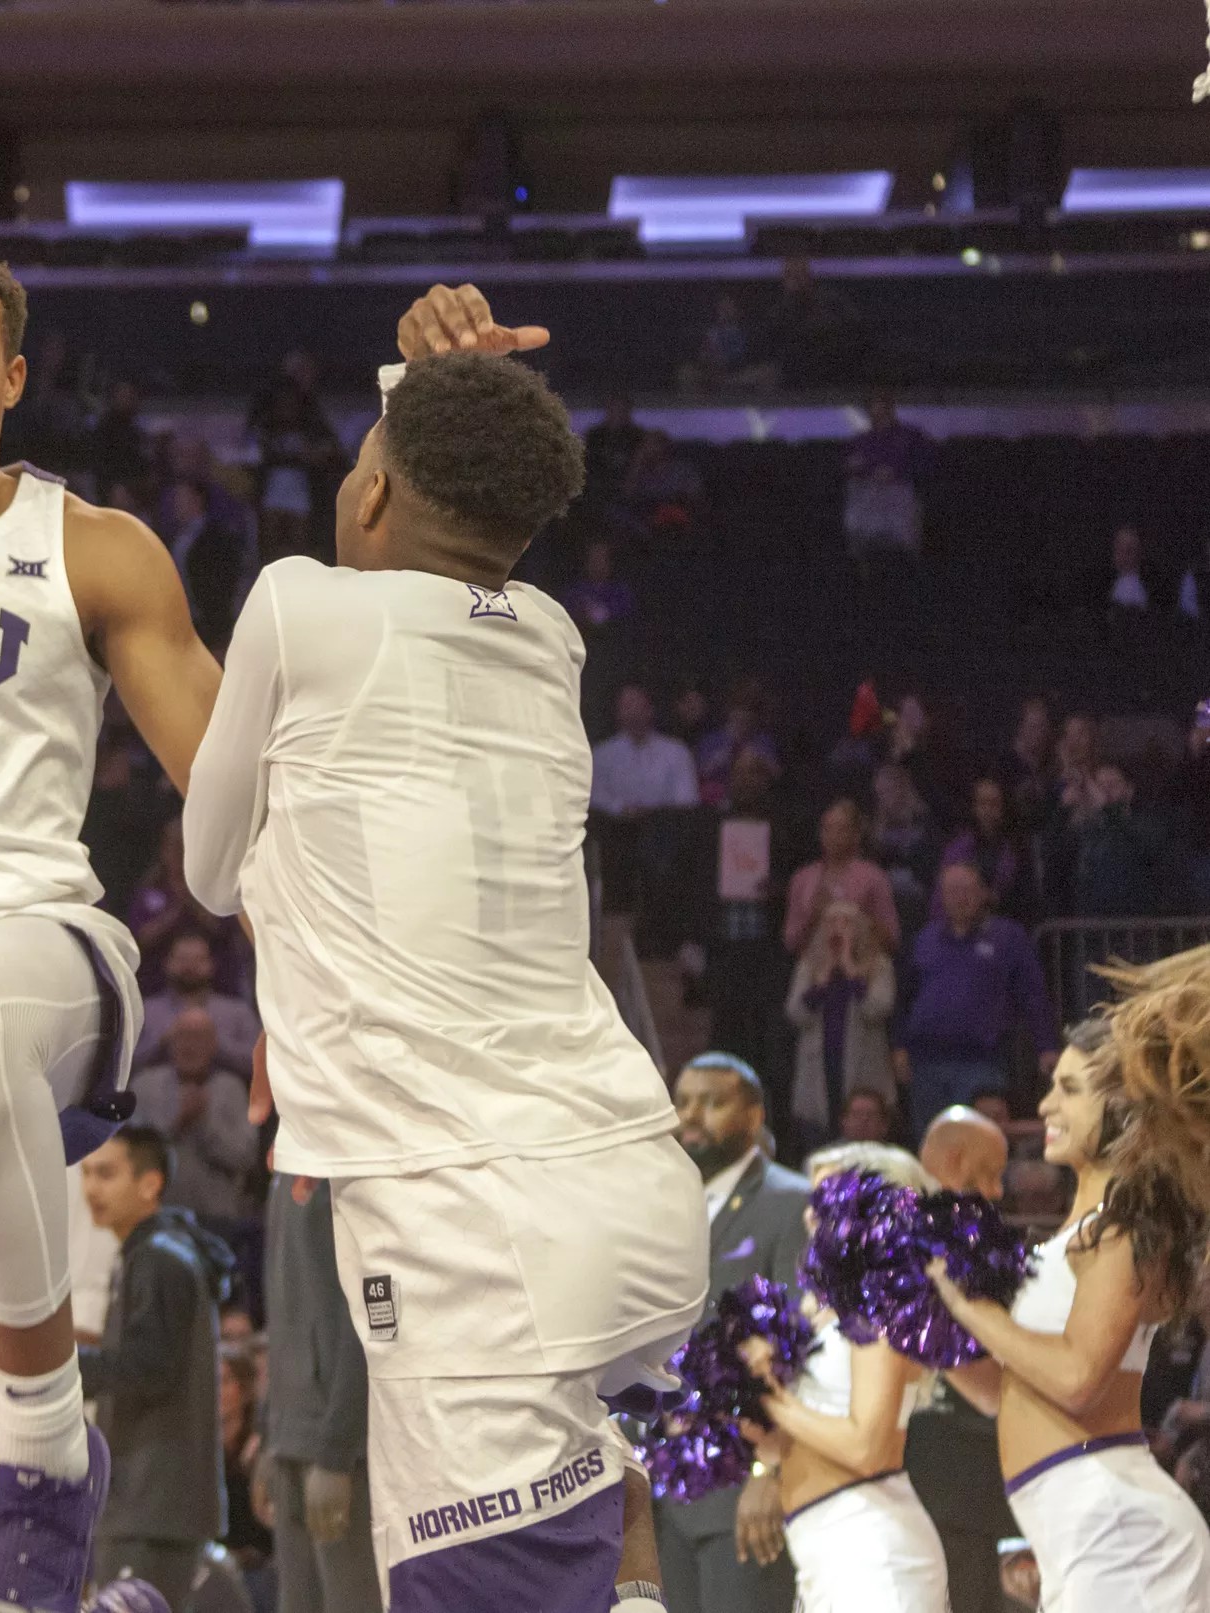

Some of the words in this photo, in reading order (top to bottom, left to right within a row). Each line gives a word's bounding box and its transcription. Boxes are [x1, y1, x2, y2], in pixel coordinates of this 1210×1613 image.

[369, 1282, 385, 1298] 46
[408, 1488, 523, 1544] HORNED
[530, 1448, 605, 1509] FROGS
